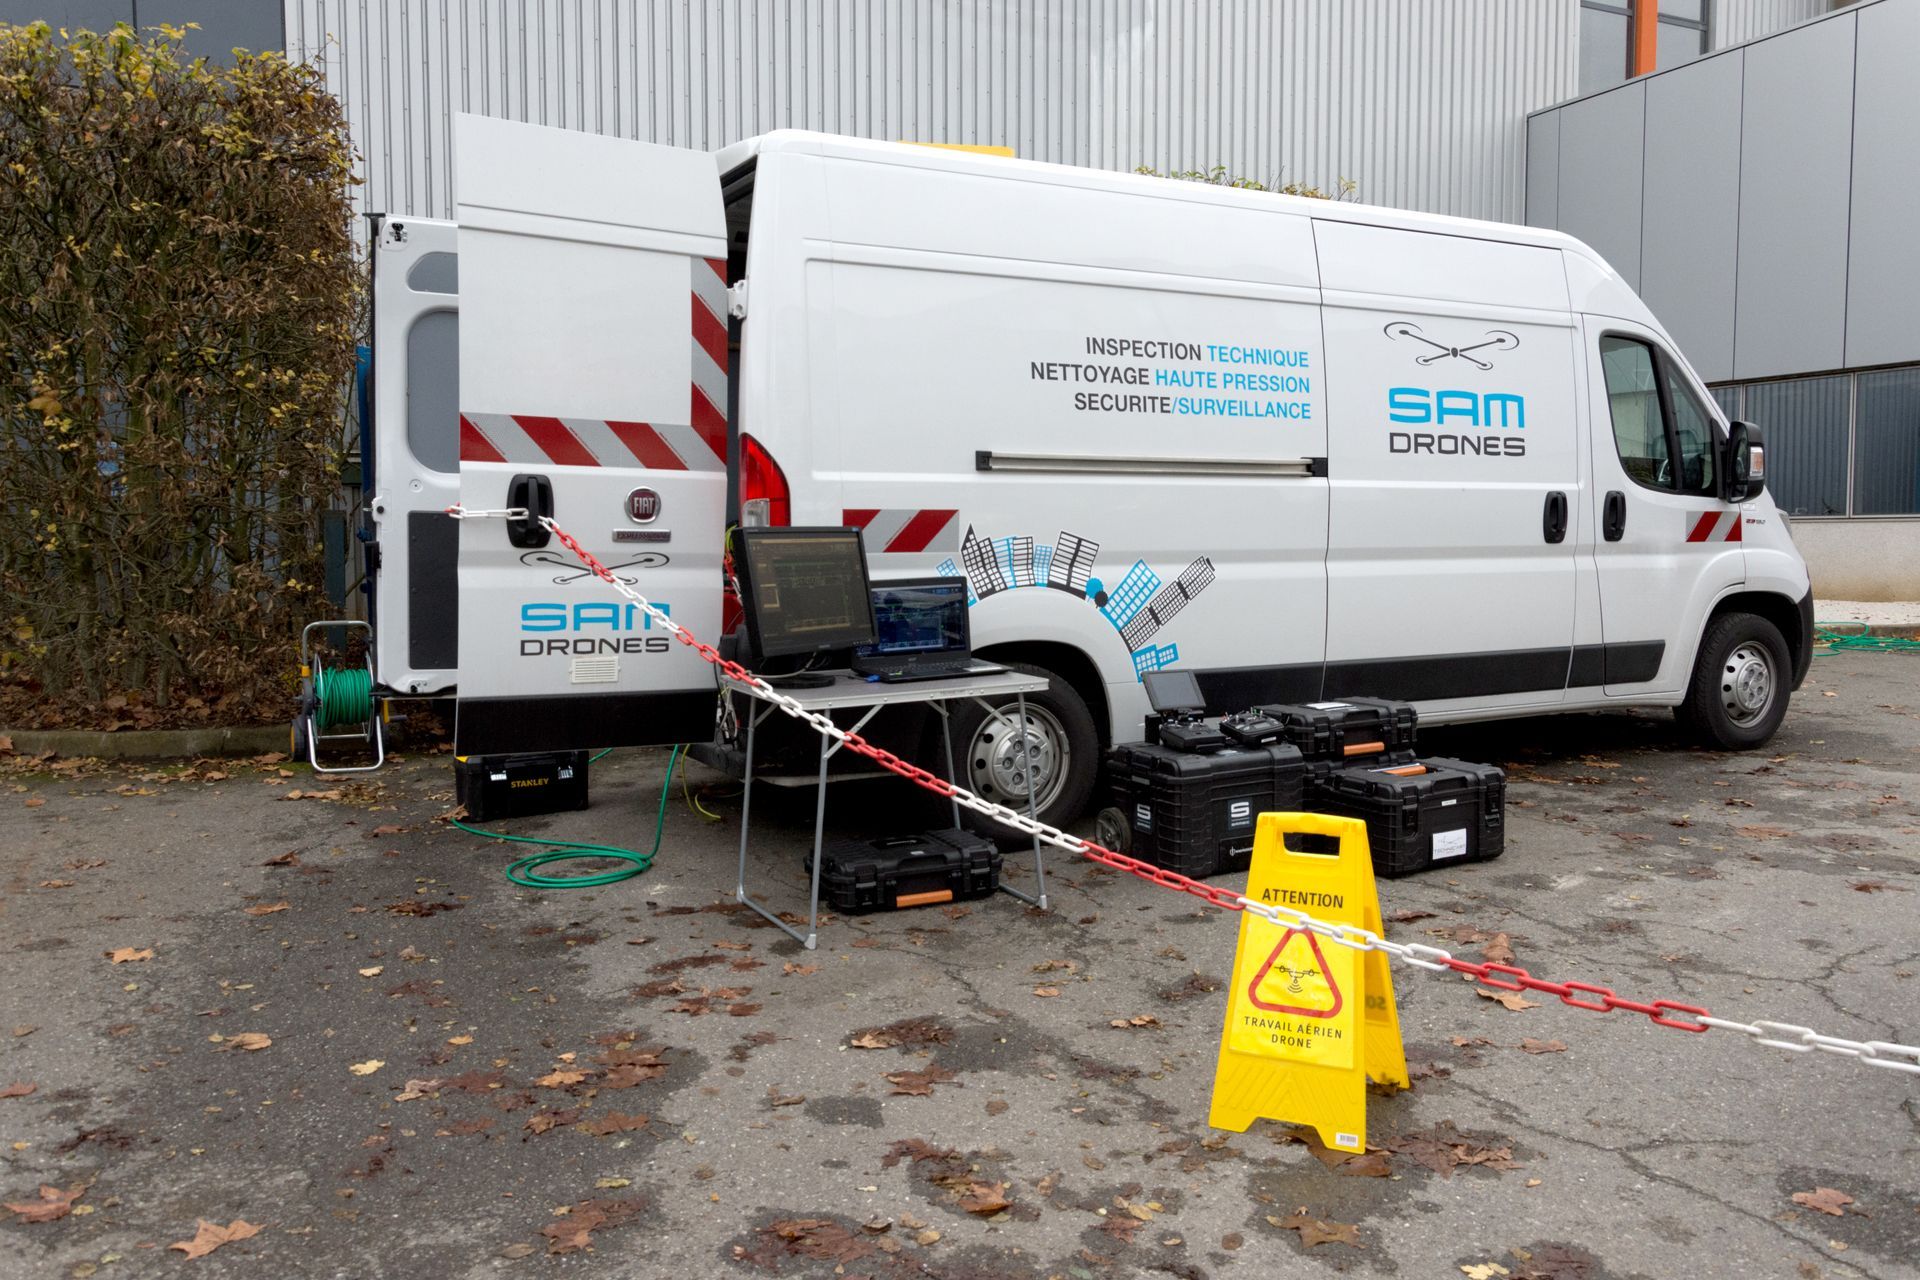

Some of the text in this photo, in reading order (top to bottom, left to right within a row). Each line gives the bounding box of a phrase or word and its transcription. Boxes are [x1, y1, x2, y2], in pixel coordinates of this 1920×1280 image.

[1086, 337, 1309, 368] INSPECTION TECHNIQUE
[1031, 362, 1310, 393] NETTOYAGE HAUTE PRESSION
[1388, 387, 1525, 428] SAM
[1389, 432, 1526, 457] DRONES
[634, 497, 655, 514] FIAT
[521, 602, 670, 631] SAM
[520, 637, 670, 656] DRONES
[511, 777, 549, 788] STANLEY
[1262, 888, 1344, 909] ATTENTION
[1244, 1016, 1343, 1039] TRAVAIL AÉRIEN
[1271, 1034, 1312, 1049] DRONE
